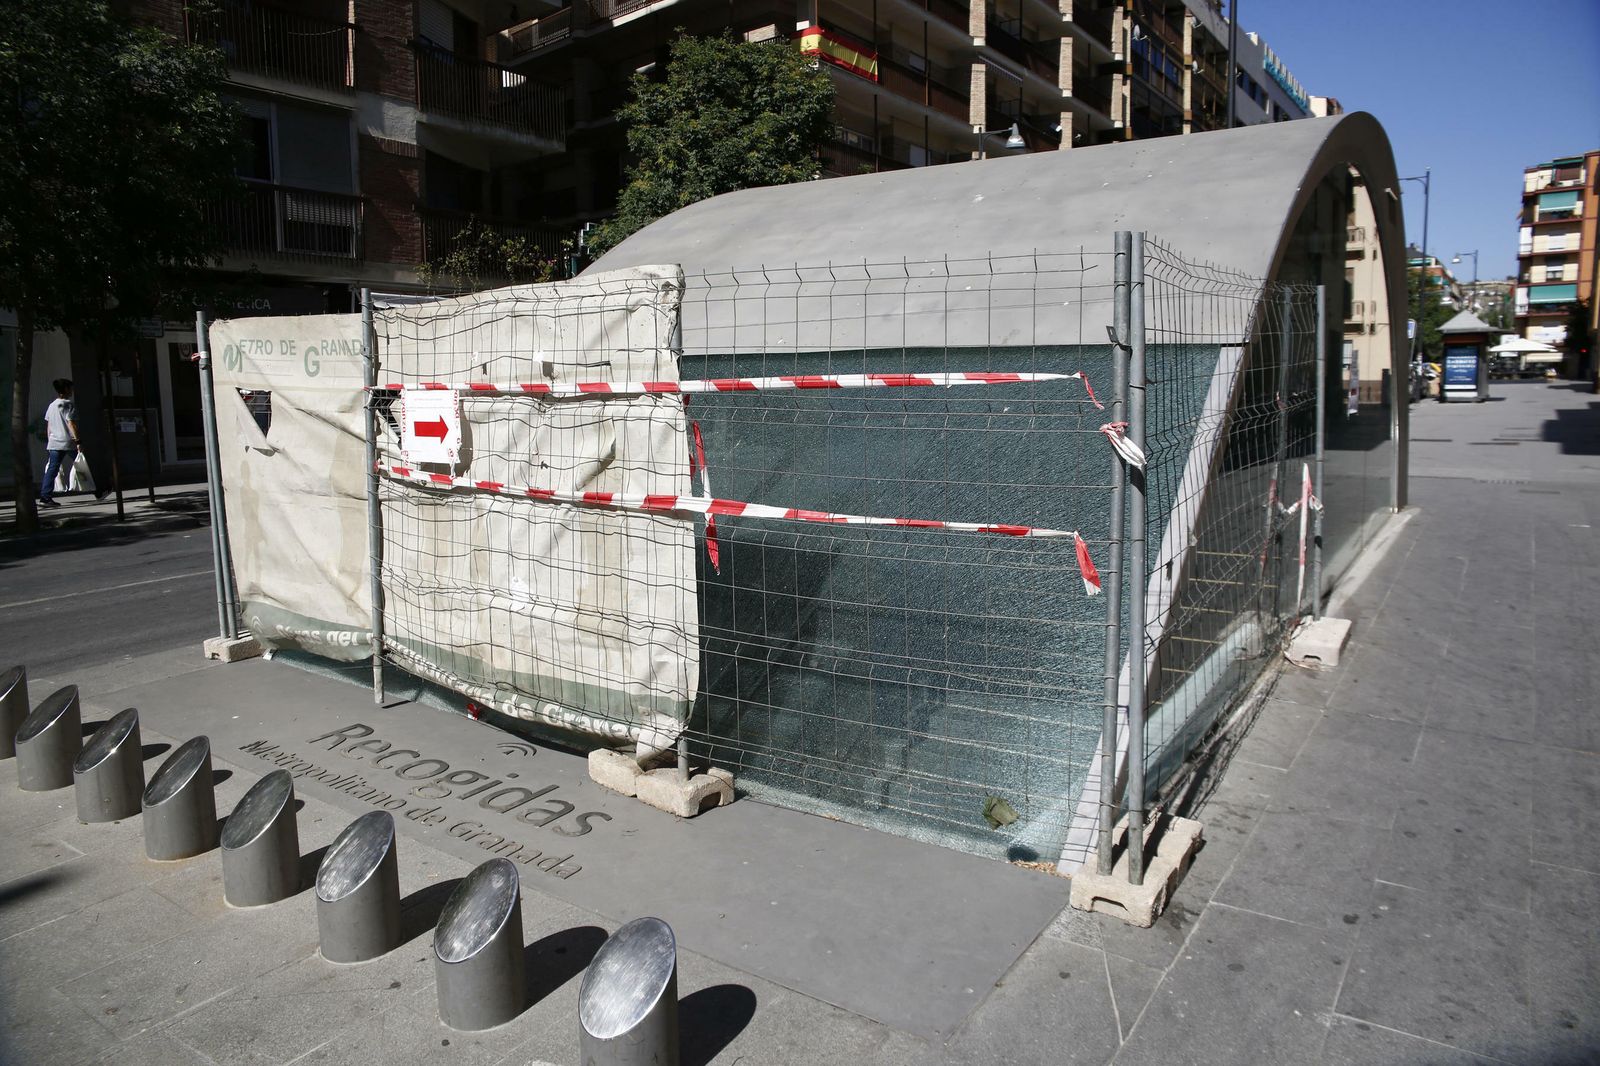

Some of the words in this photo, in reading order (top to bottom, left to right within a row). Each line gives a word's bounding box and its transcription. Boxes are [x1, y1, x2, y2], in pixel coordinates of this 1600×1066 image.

[223, 338, 274, 373] METRO
[280, 339, 297, 356] DE
[303, 338, 363, 378] GRANAD
[501, 693, 536, 722] de
[238, 739, 407, 811] Metropolitano
[404, 806, 447, 827] de
[445, 819, 583, 880] Granada
[306, 723, 613, 838] Recogidas
